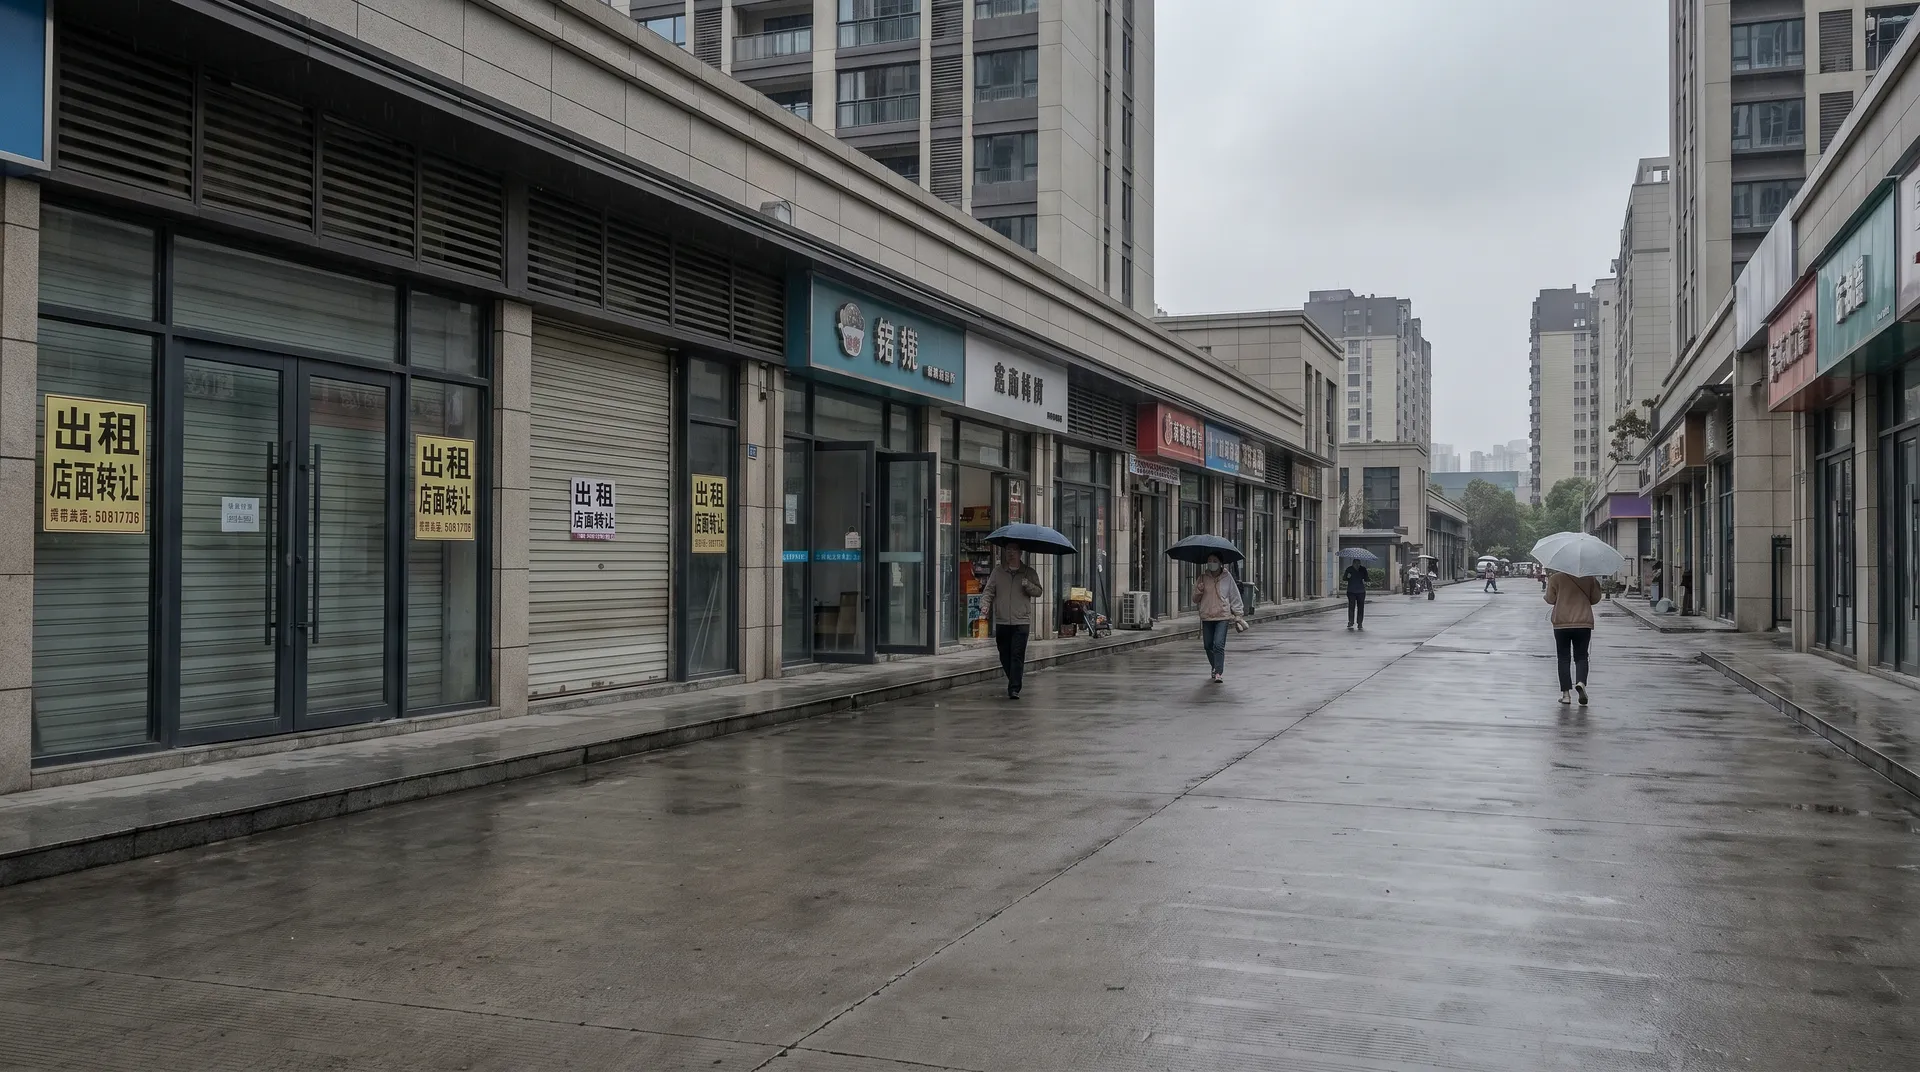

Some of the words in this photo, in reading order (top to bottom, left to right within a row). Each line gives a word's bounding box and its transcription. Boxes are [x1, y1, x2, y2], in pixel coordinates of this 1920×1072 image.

[56, 407, 139, 455] 出租
[422, 444, 471, 479] 出租
[50, 459, 139, 502] 店面转让
[575, 481, 613, 507] 出租
[695, 481, 724, 507] 出租
[419, 483, 471, 516] 店面转让
[573, 510, 614, 529] 店面转让
